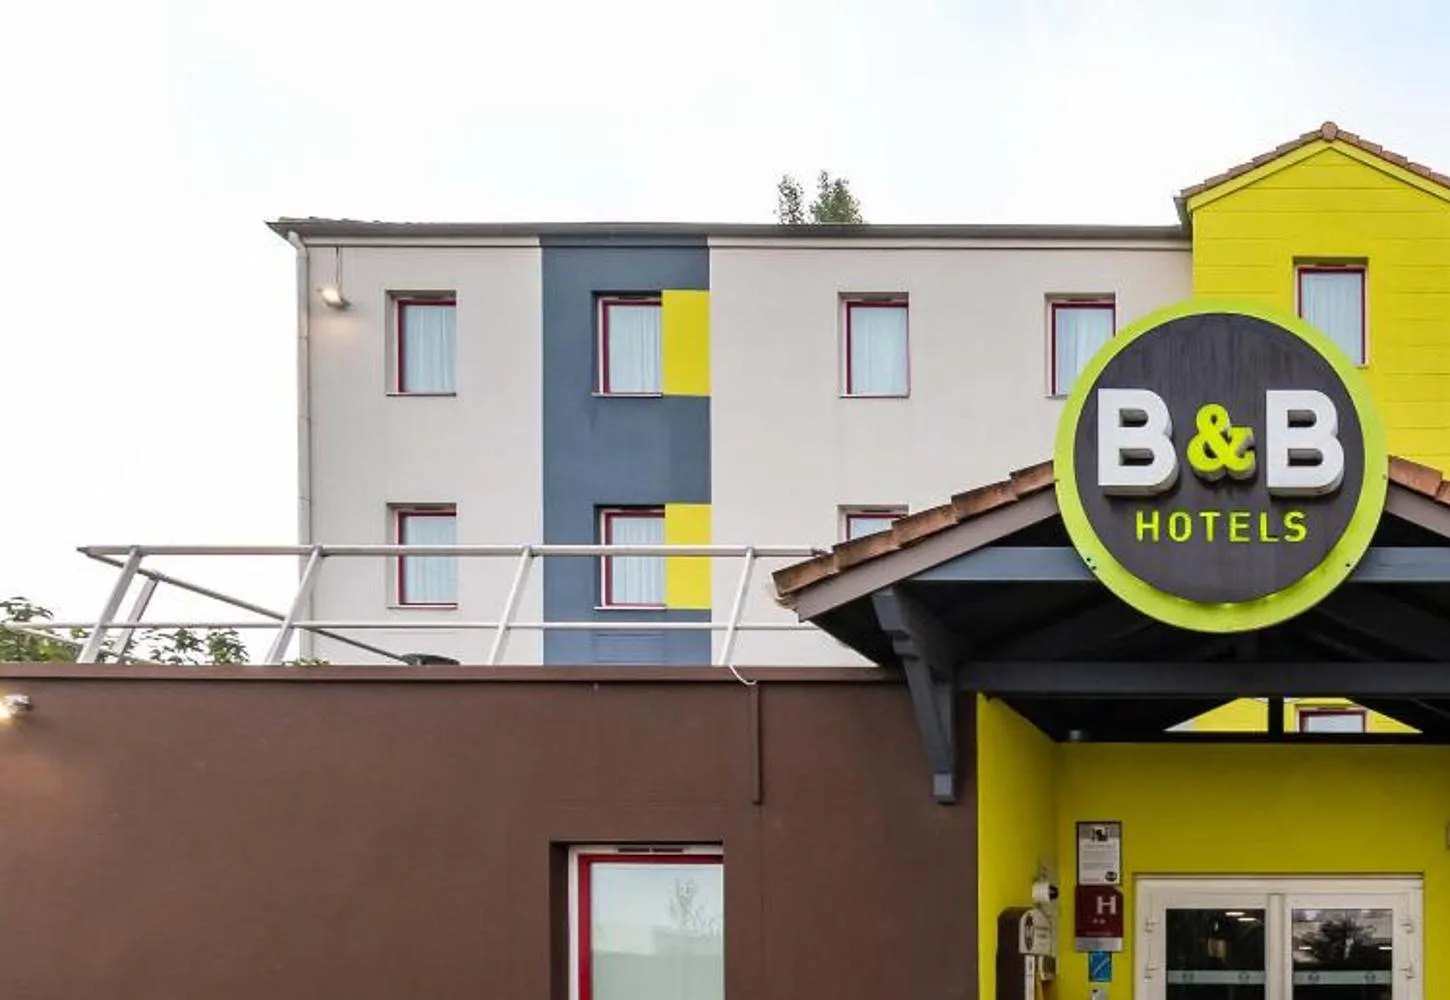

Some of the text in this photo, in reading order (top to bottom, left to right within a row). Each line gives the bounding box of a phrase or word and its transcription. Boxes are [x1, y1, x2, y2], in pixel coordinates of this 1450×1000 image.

[1097, 388, 1345, 497] B&B
[1135, 510, 1309, 543] HOTELS
[1096, 895, 1118, 916] H
